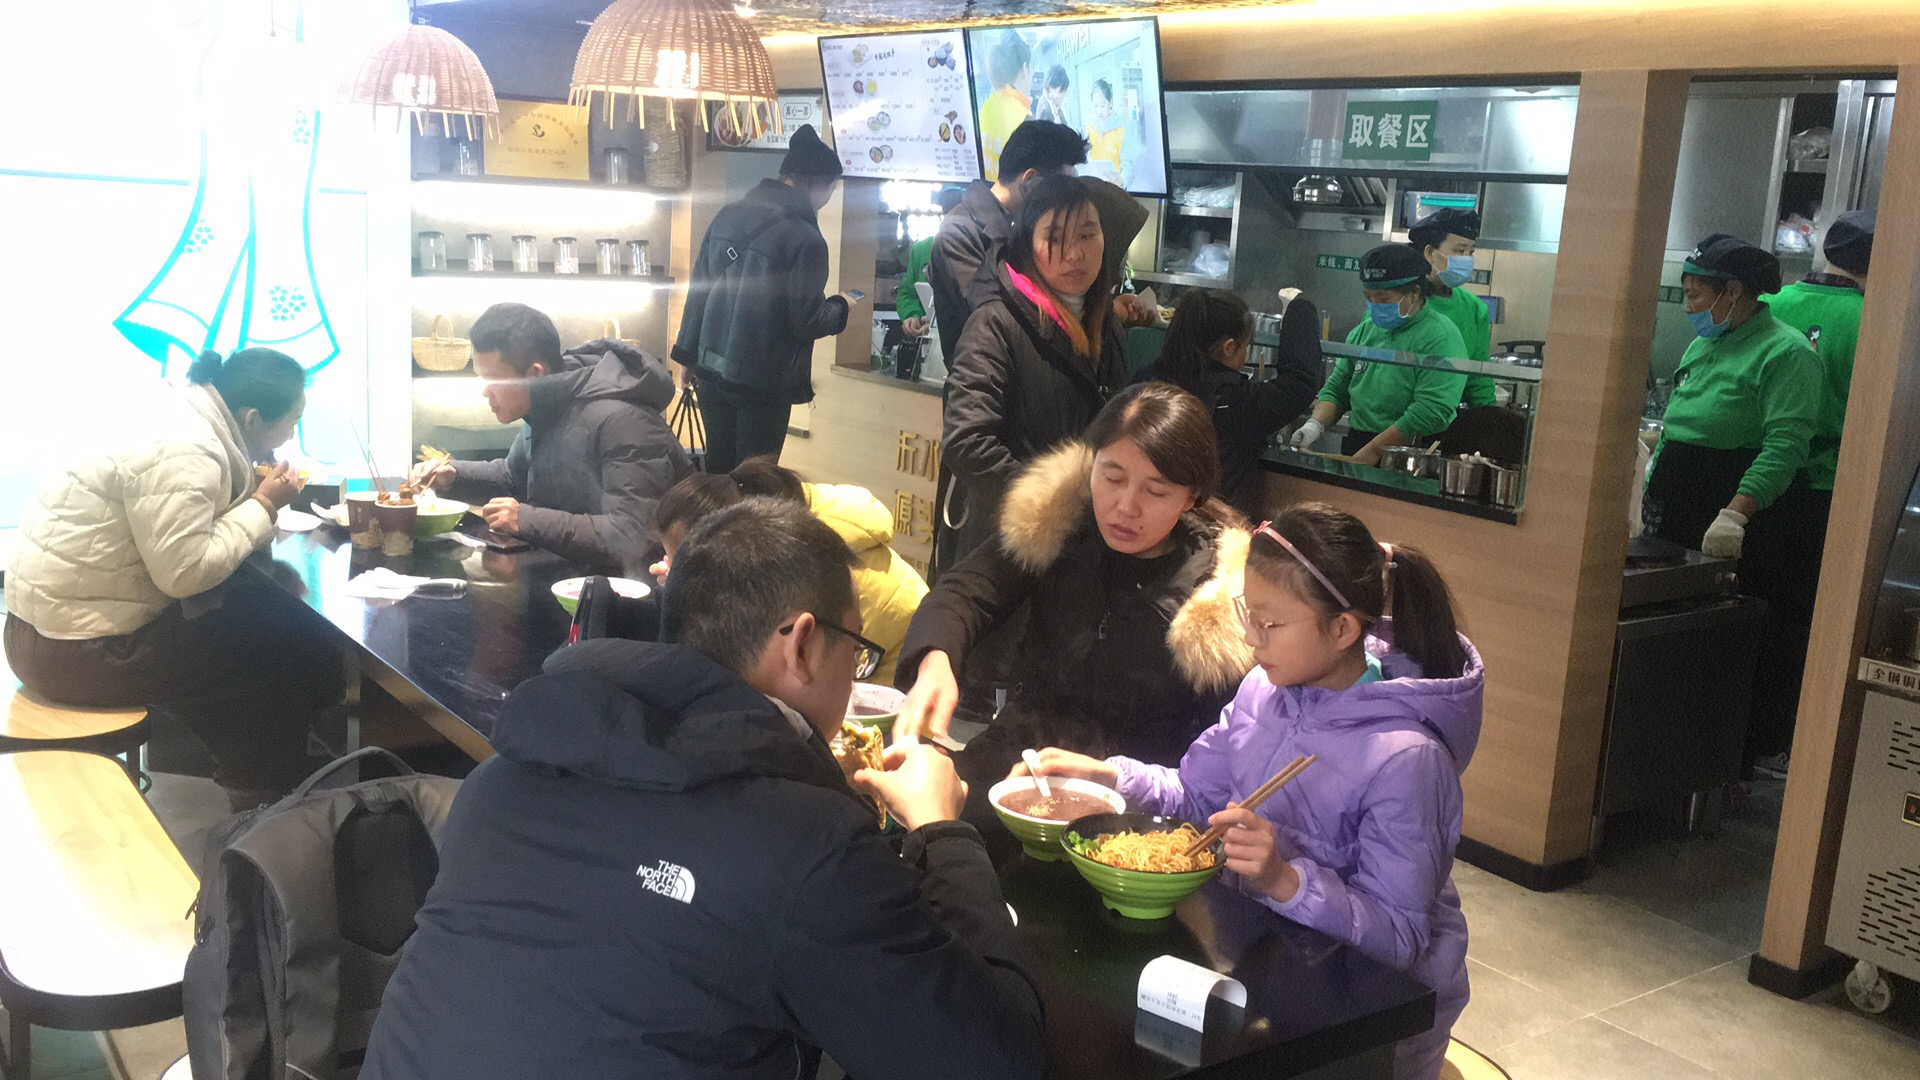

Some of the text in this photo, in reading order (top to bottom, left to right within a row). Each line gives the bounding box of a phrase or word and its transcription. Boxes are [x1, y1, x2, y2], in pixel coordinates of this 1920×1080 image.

[1057, 23, 1091, 61] HUAWEI
[1349, 113, 1431, 149] 取餐区
[636, 864, 677, 886] NORTH
[657, 859, 681, 875] THE
[641, 878, 674, 897] FACE
